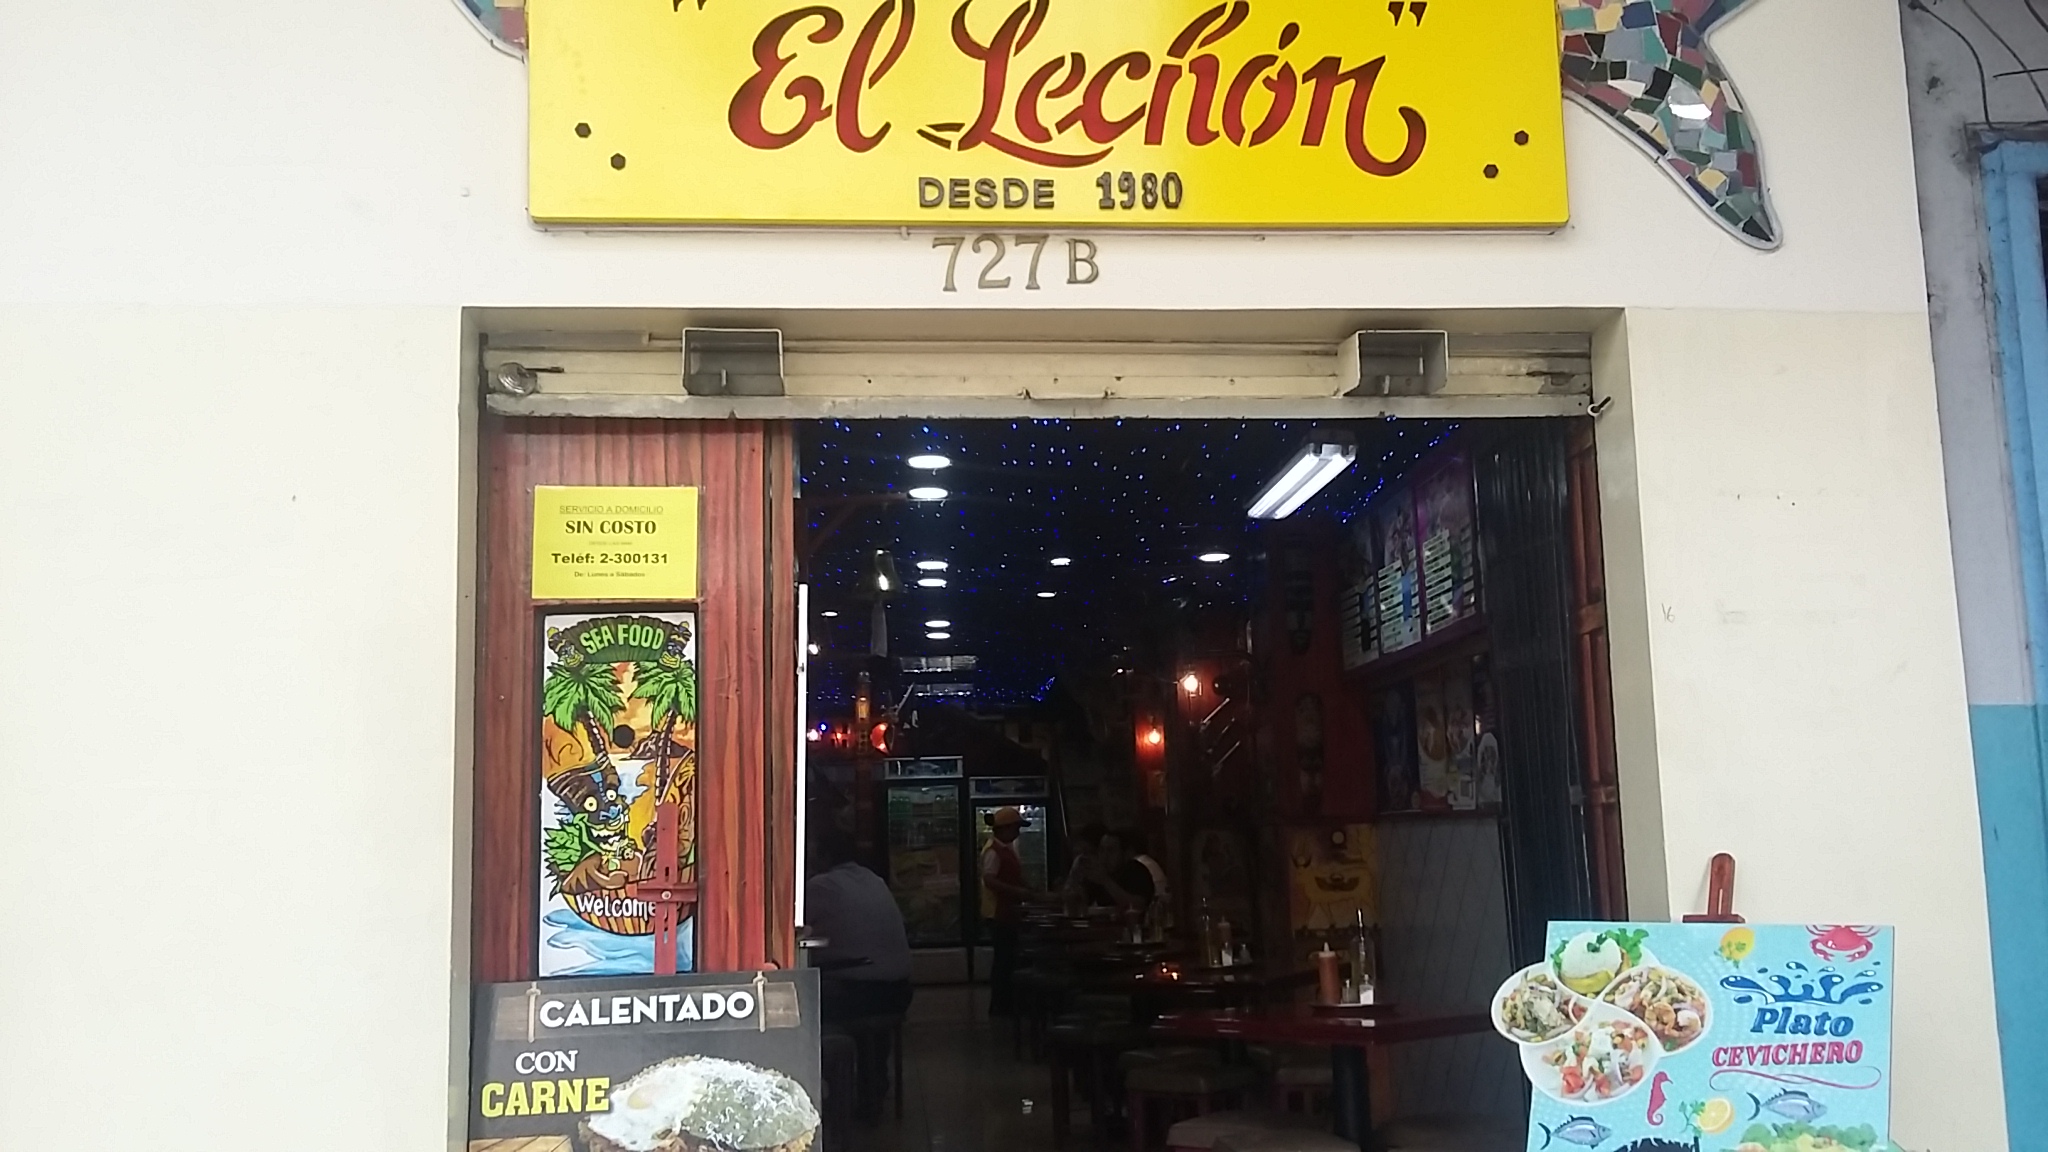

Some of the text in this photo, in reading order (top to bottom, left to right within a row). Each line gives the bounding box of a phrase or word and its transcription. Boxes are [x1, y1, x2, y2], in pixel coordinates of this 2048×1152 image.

[918, 171, 1183, 210] DESDE 1980
[932, 234, 1050, 292] 727
[559, 505, 664, 515] SERVICIO A DOMICILIO
[565, 520, 657, 535] SIN COSTO
[551, 552, 668, 565] Teléf: 2-300131
[579, 623, 665, 655] SEA FOOD
[539, 991, 755, 1029] CALENTADO
[1750, 1006, 1855, 1037] Plato
[515, 1050, 579, 1075] CON
[1711, 1040, 1864, 1067] CEVICHERO
[481, 1077, 610, 1119] CARNE
